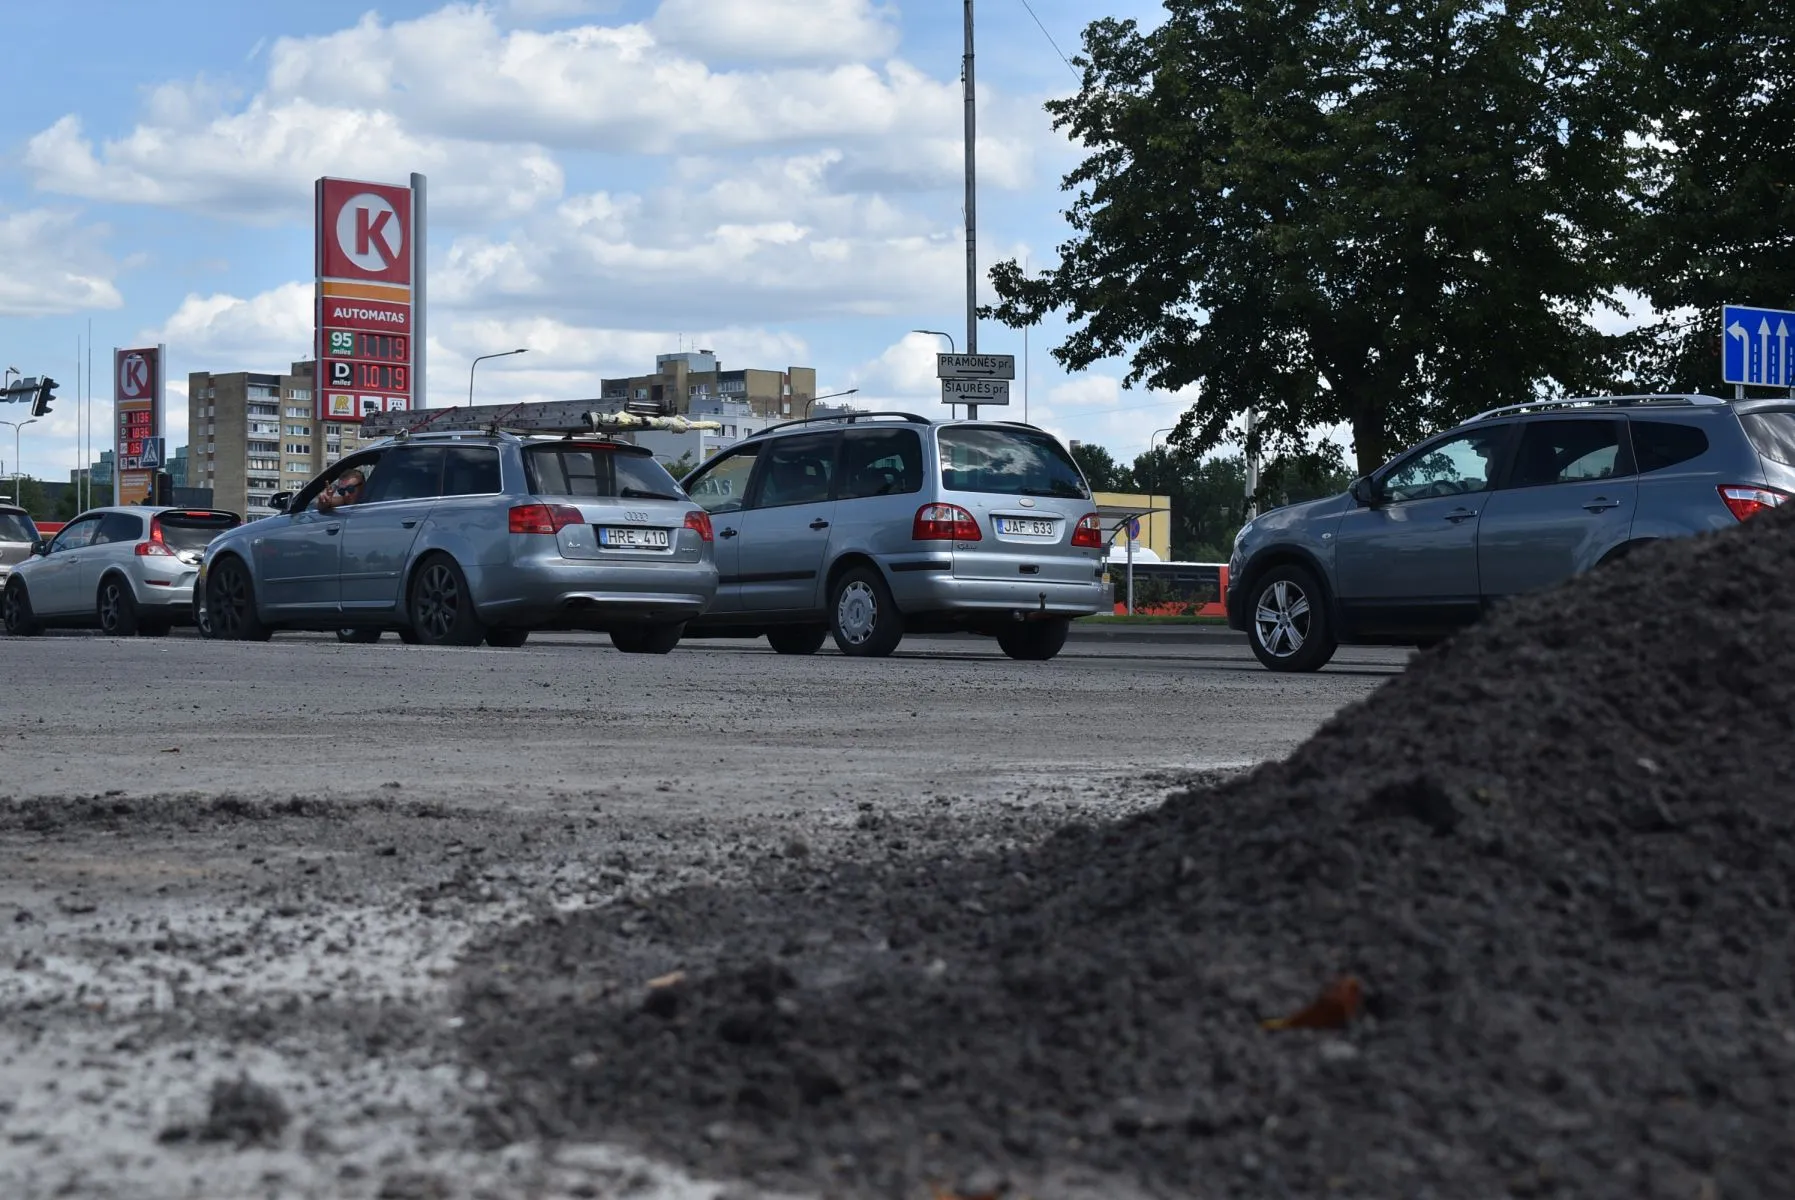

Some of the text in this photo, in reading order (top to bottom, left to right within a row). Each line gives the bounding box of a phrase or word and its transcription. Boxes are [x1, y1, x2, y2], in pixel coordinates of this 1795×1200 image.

[355, 207, 397, 266] K
[333, 307, 405, 324] AUTOMATAS
[331, 332, 352, 347] 95
[332, 348, 351, 356] miles
[335, 363, 350, 378] D
[941, 356, 1012, 370] PRAMONĖS pr.
[332, 379, 351, 387] miles
[945, 380, 1007, 395] ŠIAURĖS pr.
[1004, 518, 1053, 535] JAF 633
[608, 529, 666, 545] HRE 410
